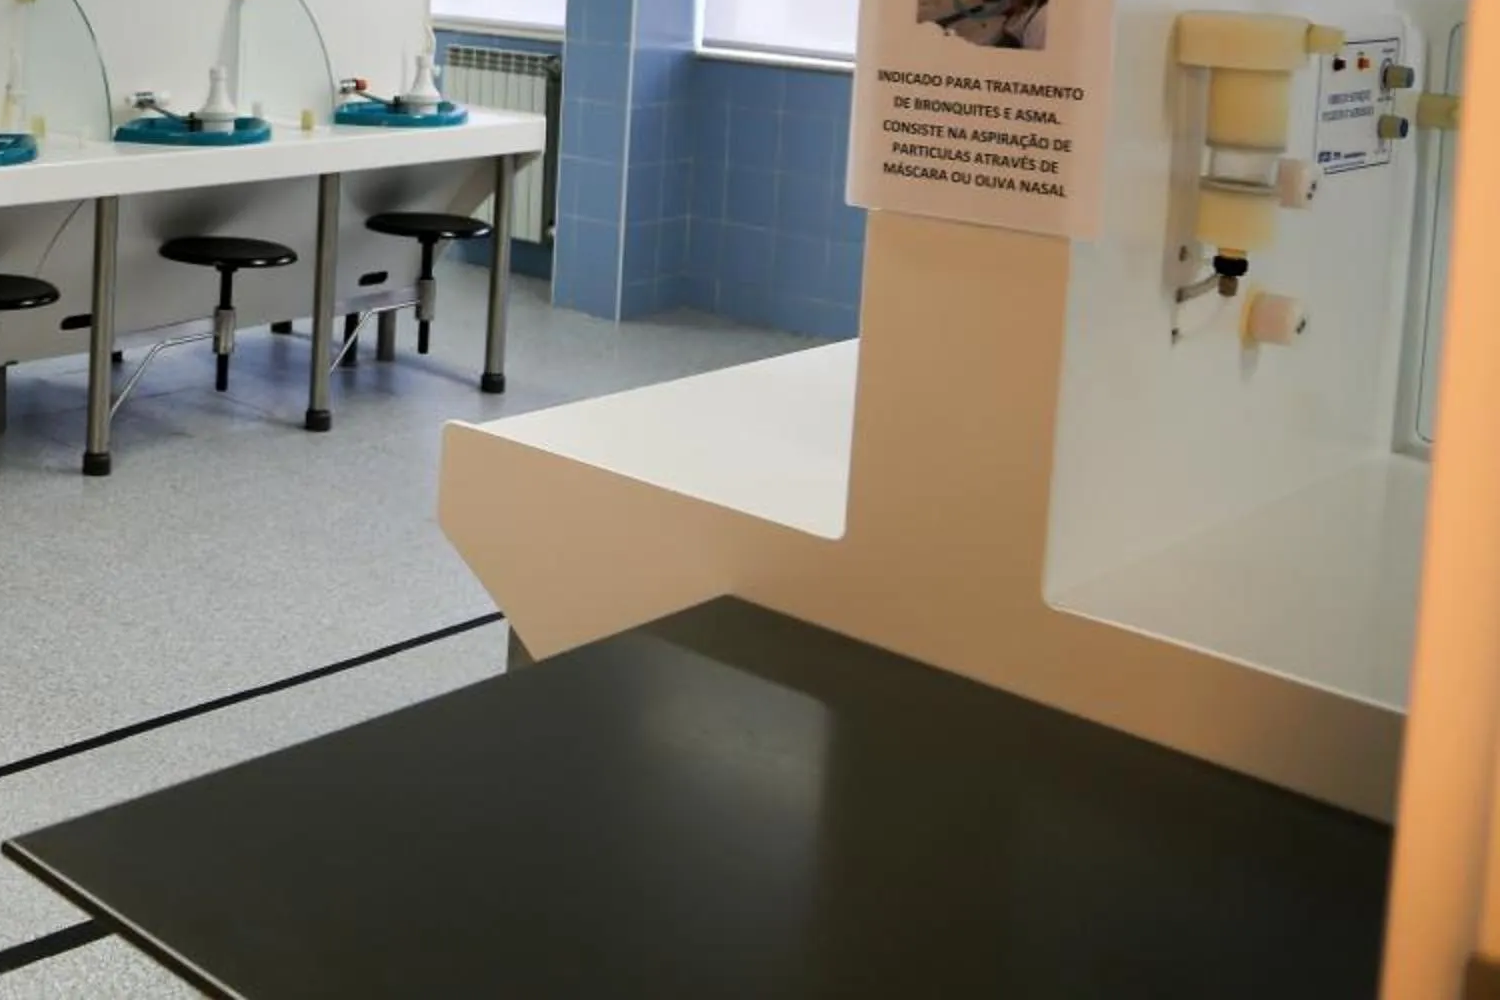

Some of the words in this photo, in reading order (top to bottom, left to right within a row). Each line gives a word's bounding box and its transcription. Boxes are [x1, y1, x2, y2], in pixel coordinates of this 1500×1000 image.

[877, 69, 943, 87] INDICADO
[945, 75, 982, 91] PARA
[984, 79, 1085, 101] TRATAMENTO
[893, 96, 911, 109] DE
[913, 98, 1001, 119] BRONQUITES
[1003, 107, 1011, 120] E
[1014, 109, 1061, 125] ASMA.
[883, 119, 945, 138] CONSISTE
[947, 126, 968, 141] NA
[970, 130, 1049, 151] ASPIRAÇÃO
[1052, 138, 1073, 153] DE
[974, 152, 1037, 172] ATRAVÉS
[1039, 159, 1060, 174] DE
[883, 161, 949, 182] MÁSCARA
[950, 171, 971, 185] OU
[974, 175, 1016, 192] OLIVA
[1019, 180, 1067, 198] NASAL
